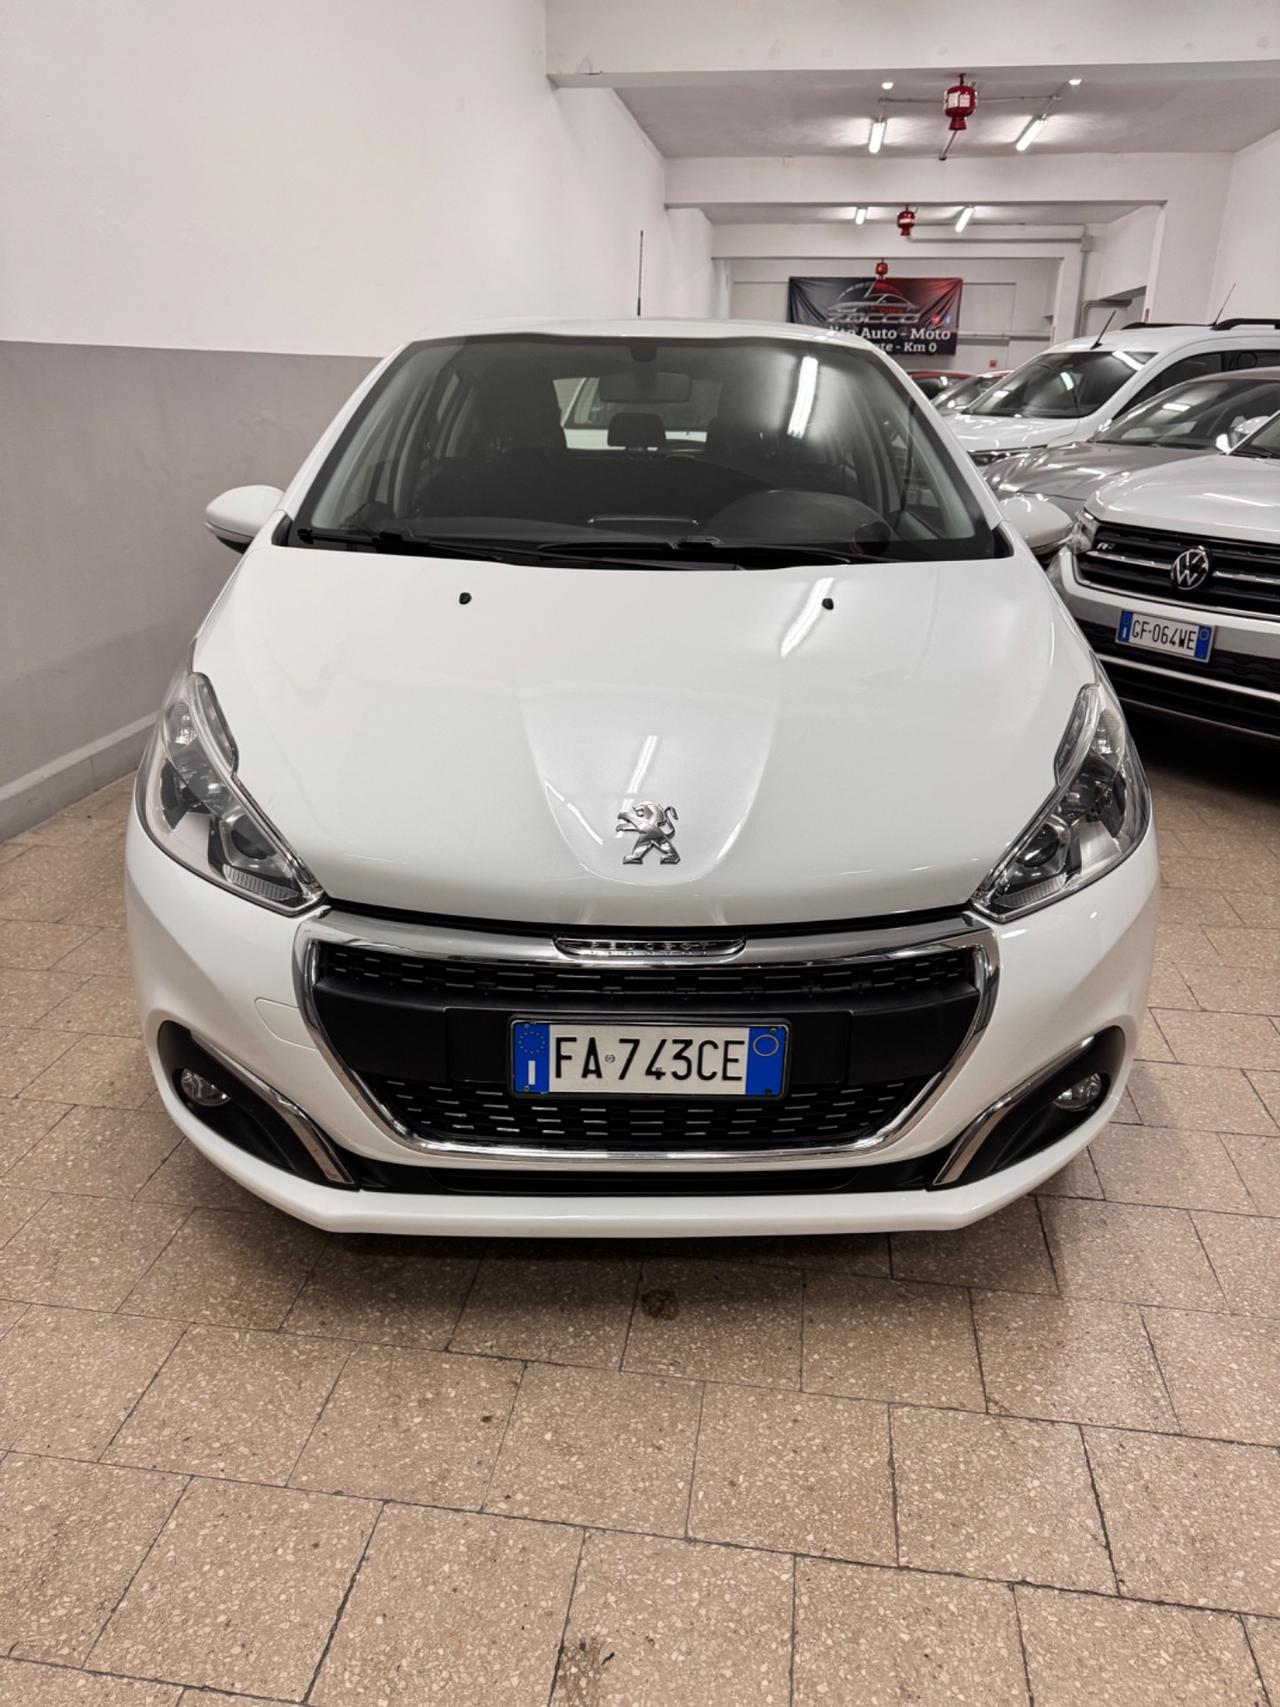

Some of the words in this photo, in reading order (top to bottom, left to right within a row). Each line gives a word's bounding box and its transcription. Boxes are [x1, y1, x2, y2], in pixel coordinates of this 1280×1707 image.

[860, 327, 897, 340] Auto
[910, 328, 951, 340] Moto
[904, 342, 926, 352] Km
[928, 342, 937, 353] 0
